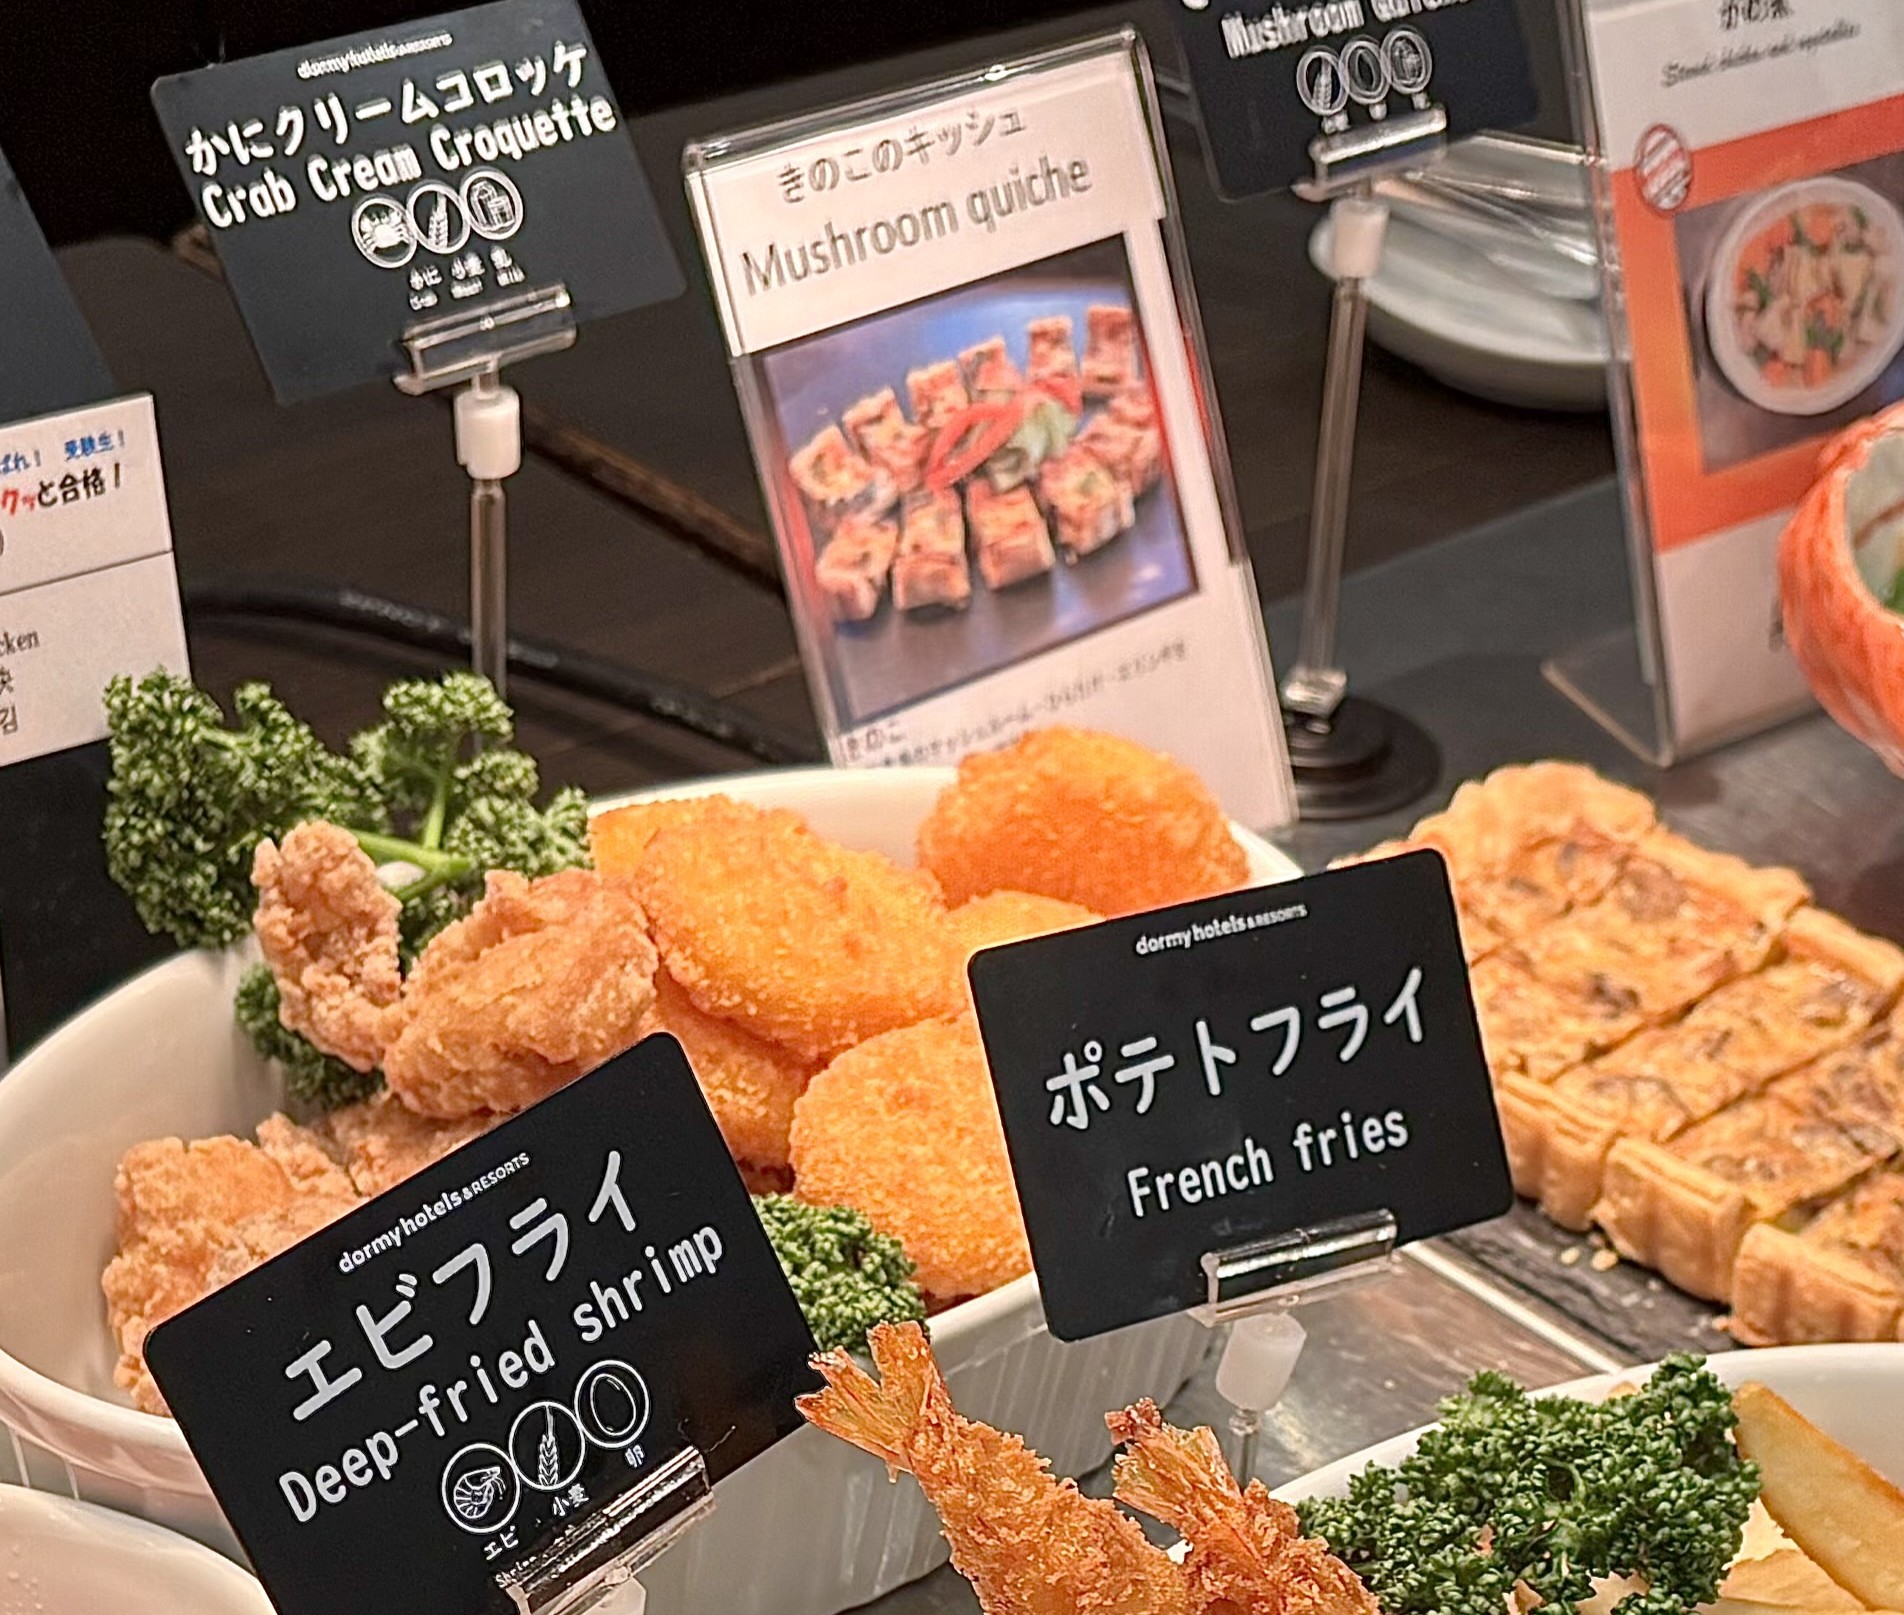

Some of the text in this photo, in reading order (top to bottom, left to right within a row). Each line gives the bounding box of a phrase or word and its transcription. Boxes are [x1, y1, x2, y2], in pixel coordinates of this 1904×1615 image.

[184, 40, 588, 176] かにクリームコロッケ
[202, 94, 618, 229] Crab Cream Croquette
[777, 110, 1027, 204] きのこのキッシュ
[741, 151, 1094, 298] Mushroom quiche
[1044, 966, 1426, 1131] ポテトフライ
[1126, 1110, 1409, 1218] French fries
[283, 1149, 638, 1421] エビフライ
[278, 1224, 725, 1523] Deep-fried shrimp
[483, 1525, 519, 1561] エビ
[552, 1482, 590, 1517] 小麦
